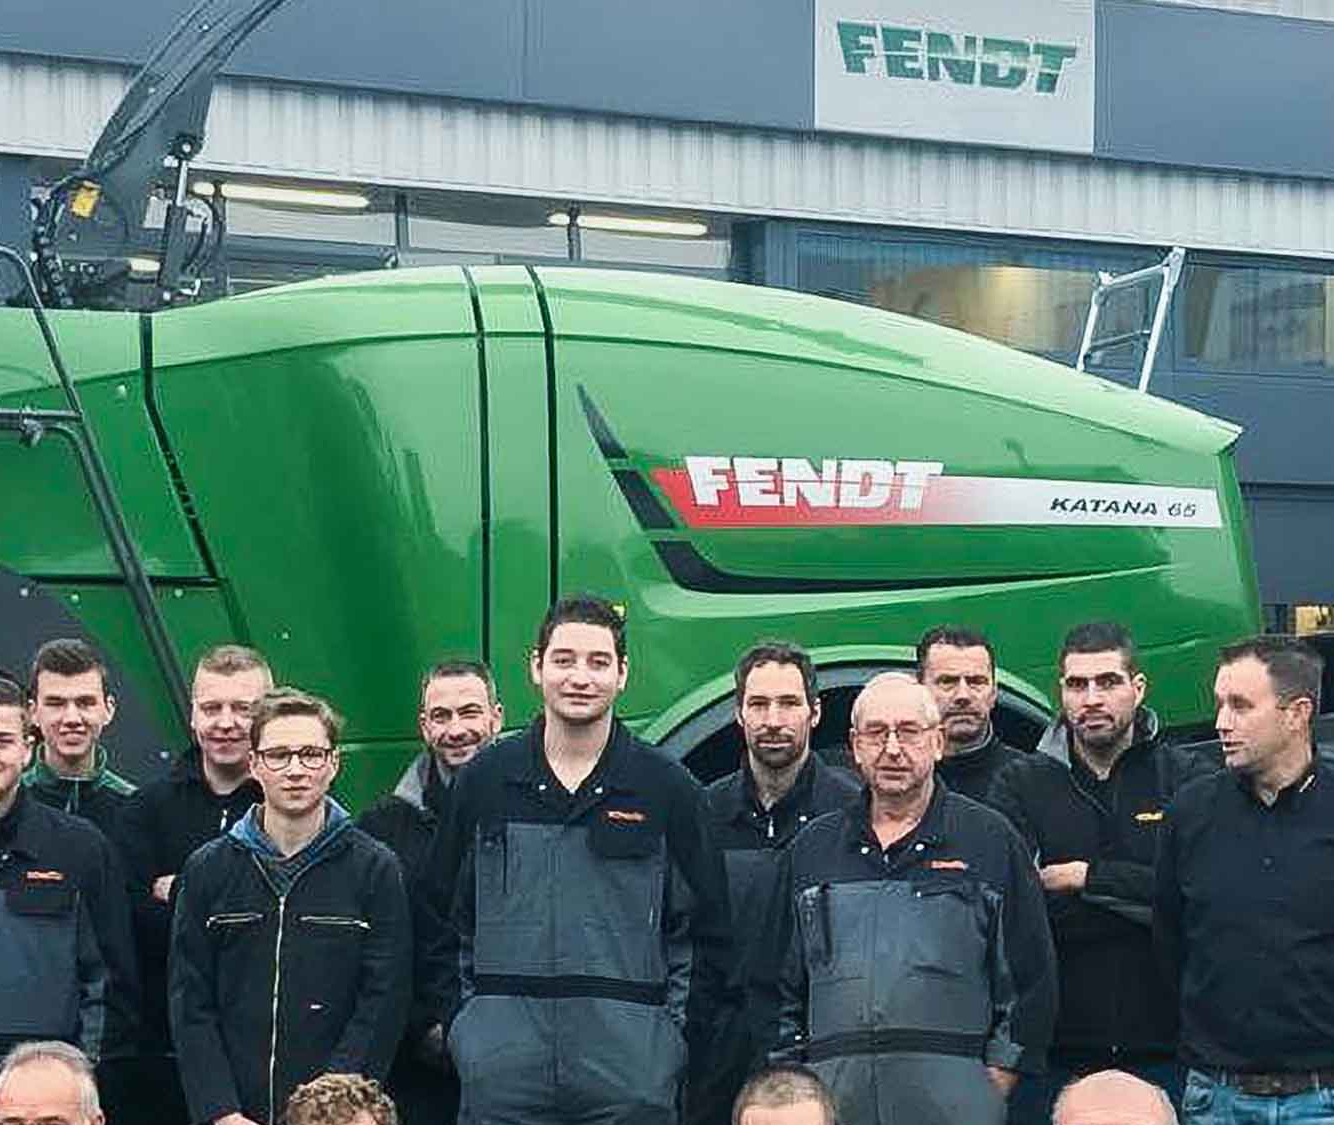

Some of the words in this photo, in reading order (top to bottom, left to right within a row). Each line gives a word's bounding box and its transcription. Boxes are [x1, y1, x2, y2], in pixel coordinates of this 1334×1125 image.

[835, 20, 1077, 94] FENDT
[684, 455, 944, 510] FENDT
[1049, 497, 1158, 516] KATANA
[1168, 501, 1197, 517] 65
